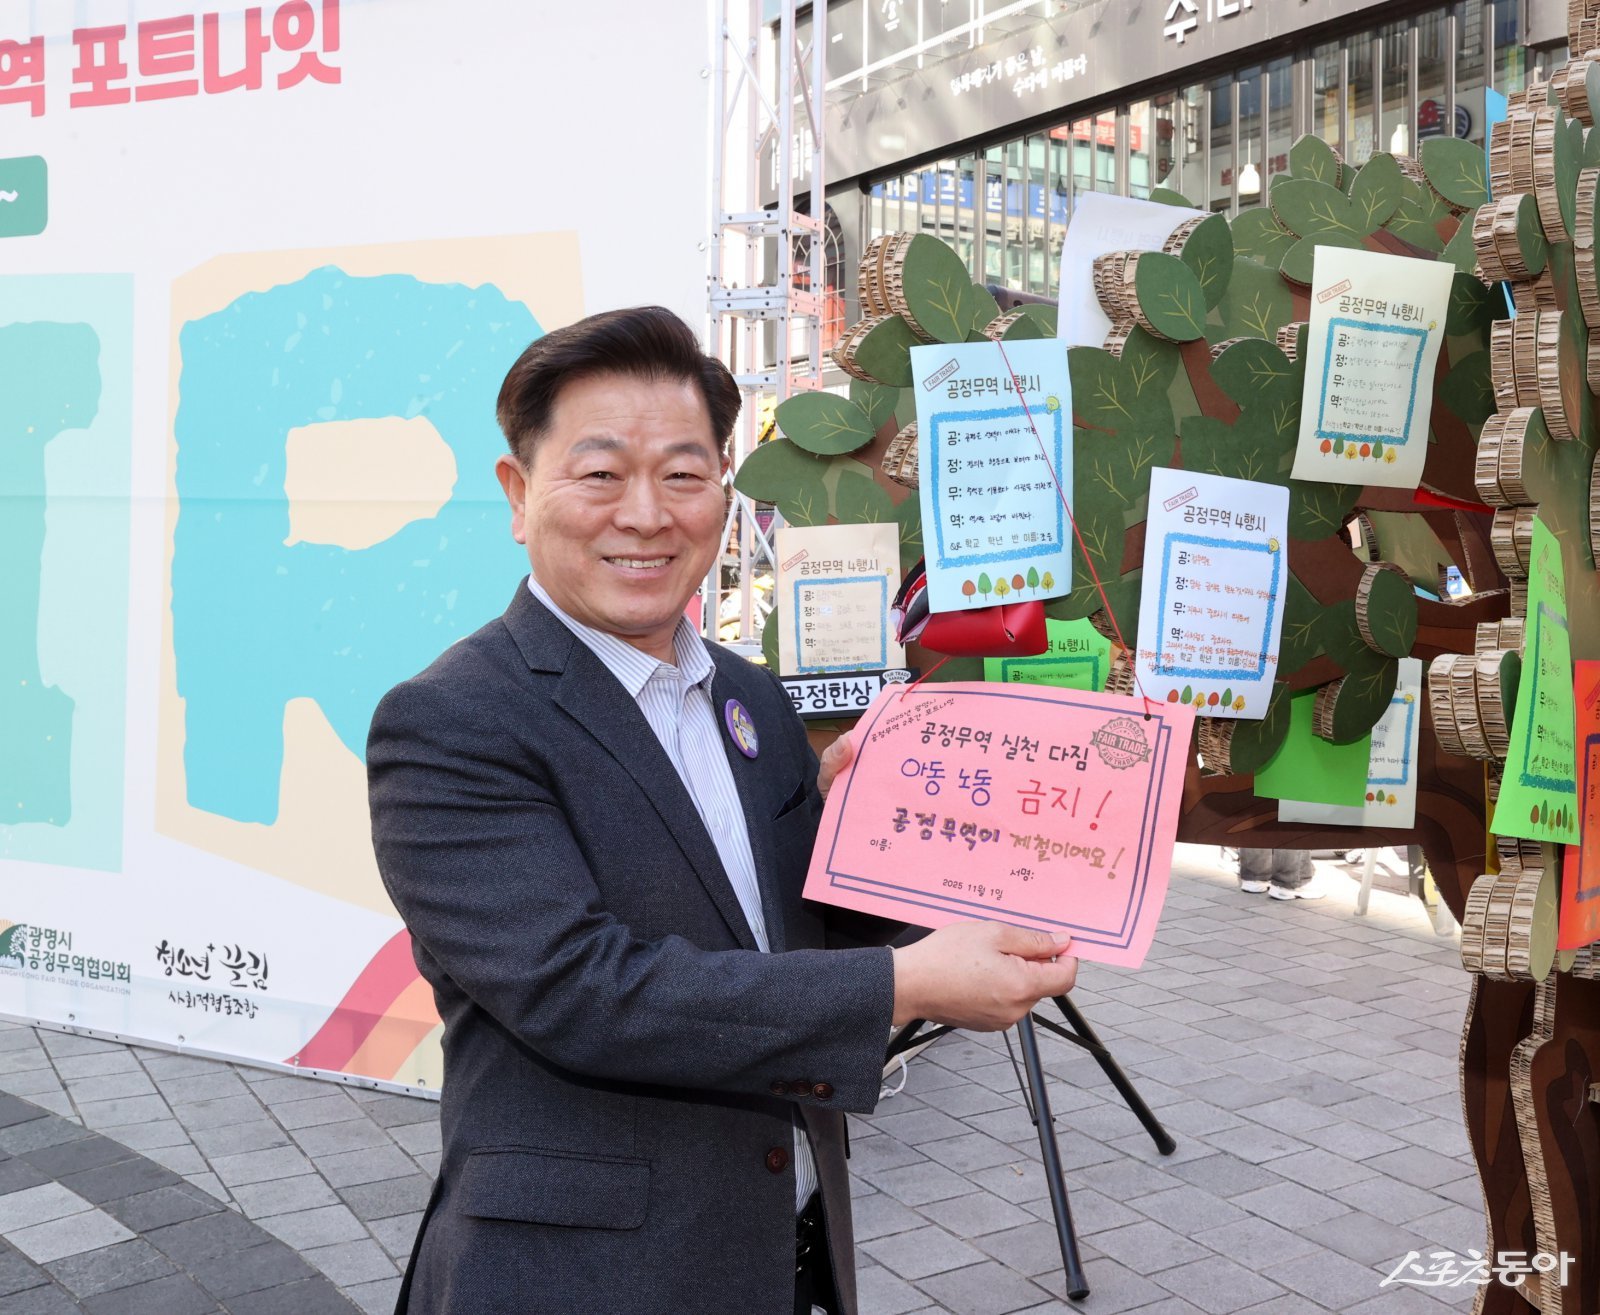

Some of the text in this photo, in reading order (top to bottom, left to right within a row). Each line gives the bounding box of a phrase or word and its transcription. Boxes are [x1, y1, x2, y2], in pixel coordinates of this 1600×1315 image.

[70, 0, 341, 109] 포트나잇
[1338, 295, 1425, 323] 공정무역 4행시
[1338, 333, 1350, 347] 공:
[1335, 353, 1348, 367] 정:
[928, 364, 956, 387] FAIR TRADE
[1333, 374, 1345, 387] 무:
[947, 374, 1041, 399] 공정무역 4행시
[1330, 394, 1342, 408] 역:
[948, 430, 961, 446] 공:
[947, 459, 962, 473] 정:
[948, 486, 962, 500] 무:
[1167, 490, 1194, 508] FAIR TRADE
[950, 514, 965, 528] 역:
[1183, 505, 1266, 532] 공정무역 4행시
[965, 538, 980, 549] 학교
[987, 535, 1003, 546] 학년
[1012, 534, 1019, 544] 반
[1178, 551, 1191, 565] 공:
[800, 558, 879, 575] 공정무역 4행시
[1175, 576, 1189, 590] 정:
[804, 590, 815, 601] 공:
[804, 606, 815, 617] 정:
[1173, 602, 1186, 616] 무:
[804, 622, 816, 632] 무:
[1171, 627, 1184, 641] 역:
[804, 638, 816, 649] 역:
[1058, 639, 1090, 652] 4행시
[786, 680, 872, 710] 공정한상
[871, 723, 900, 742] 공정무역
[925, 698, 955, 716] 포트나잇
[1108, 721, 1142, 738] FAIR TRADE
[920, 721, 1089, 772] 공정무역 실천 다짐
[1097, 731, 1147, 755] FAIR TRADE
[1102, 748, 1134, 765] FAIR TRADE
[901, 758, 946, 796] 아동
[958, 768, 993, 807] 노동
[869, 838, 892, 851] 이름:
[1010, 867, 1034, 881] 서명:
[942, 878, 1004, 900] 2025 11월 1일
[29, 926, 72, 951] 광명시
[27, 948, 131, 983] 공정무역협의회
[168, 990, 259, 1018] 사회적협동조합
